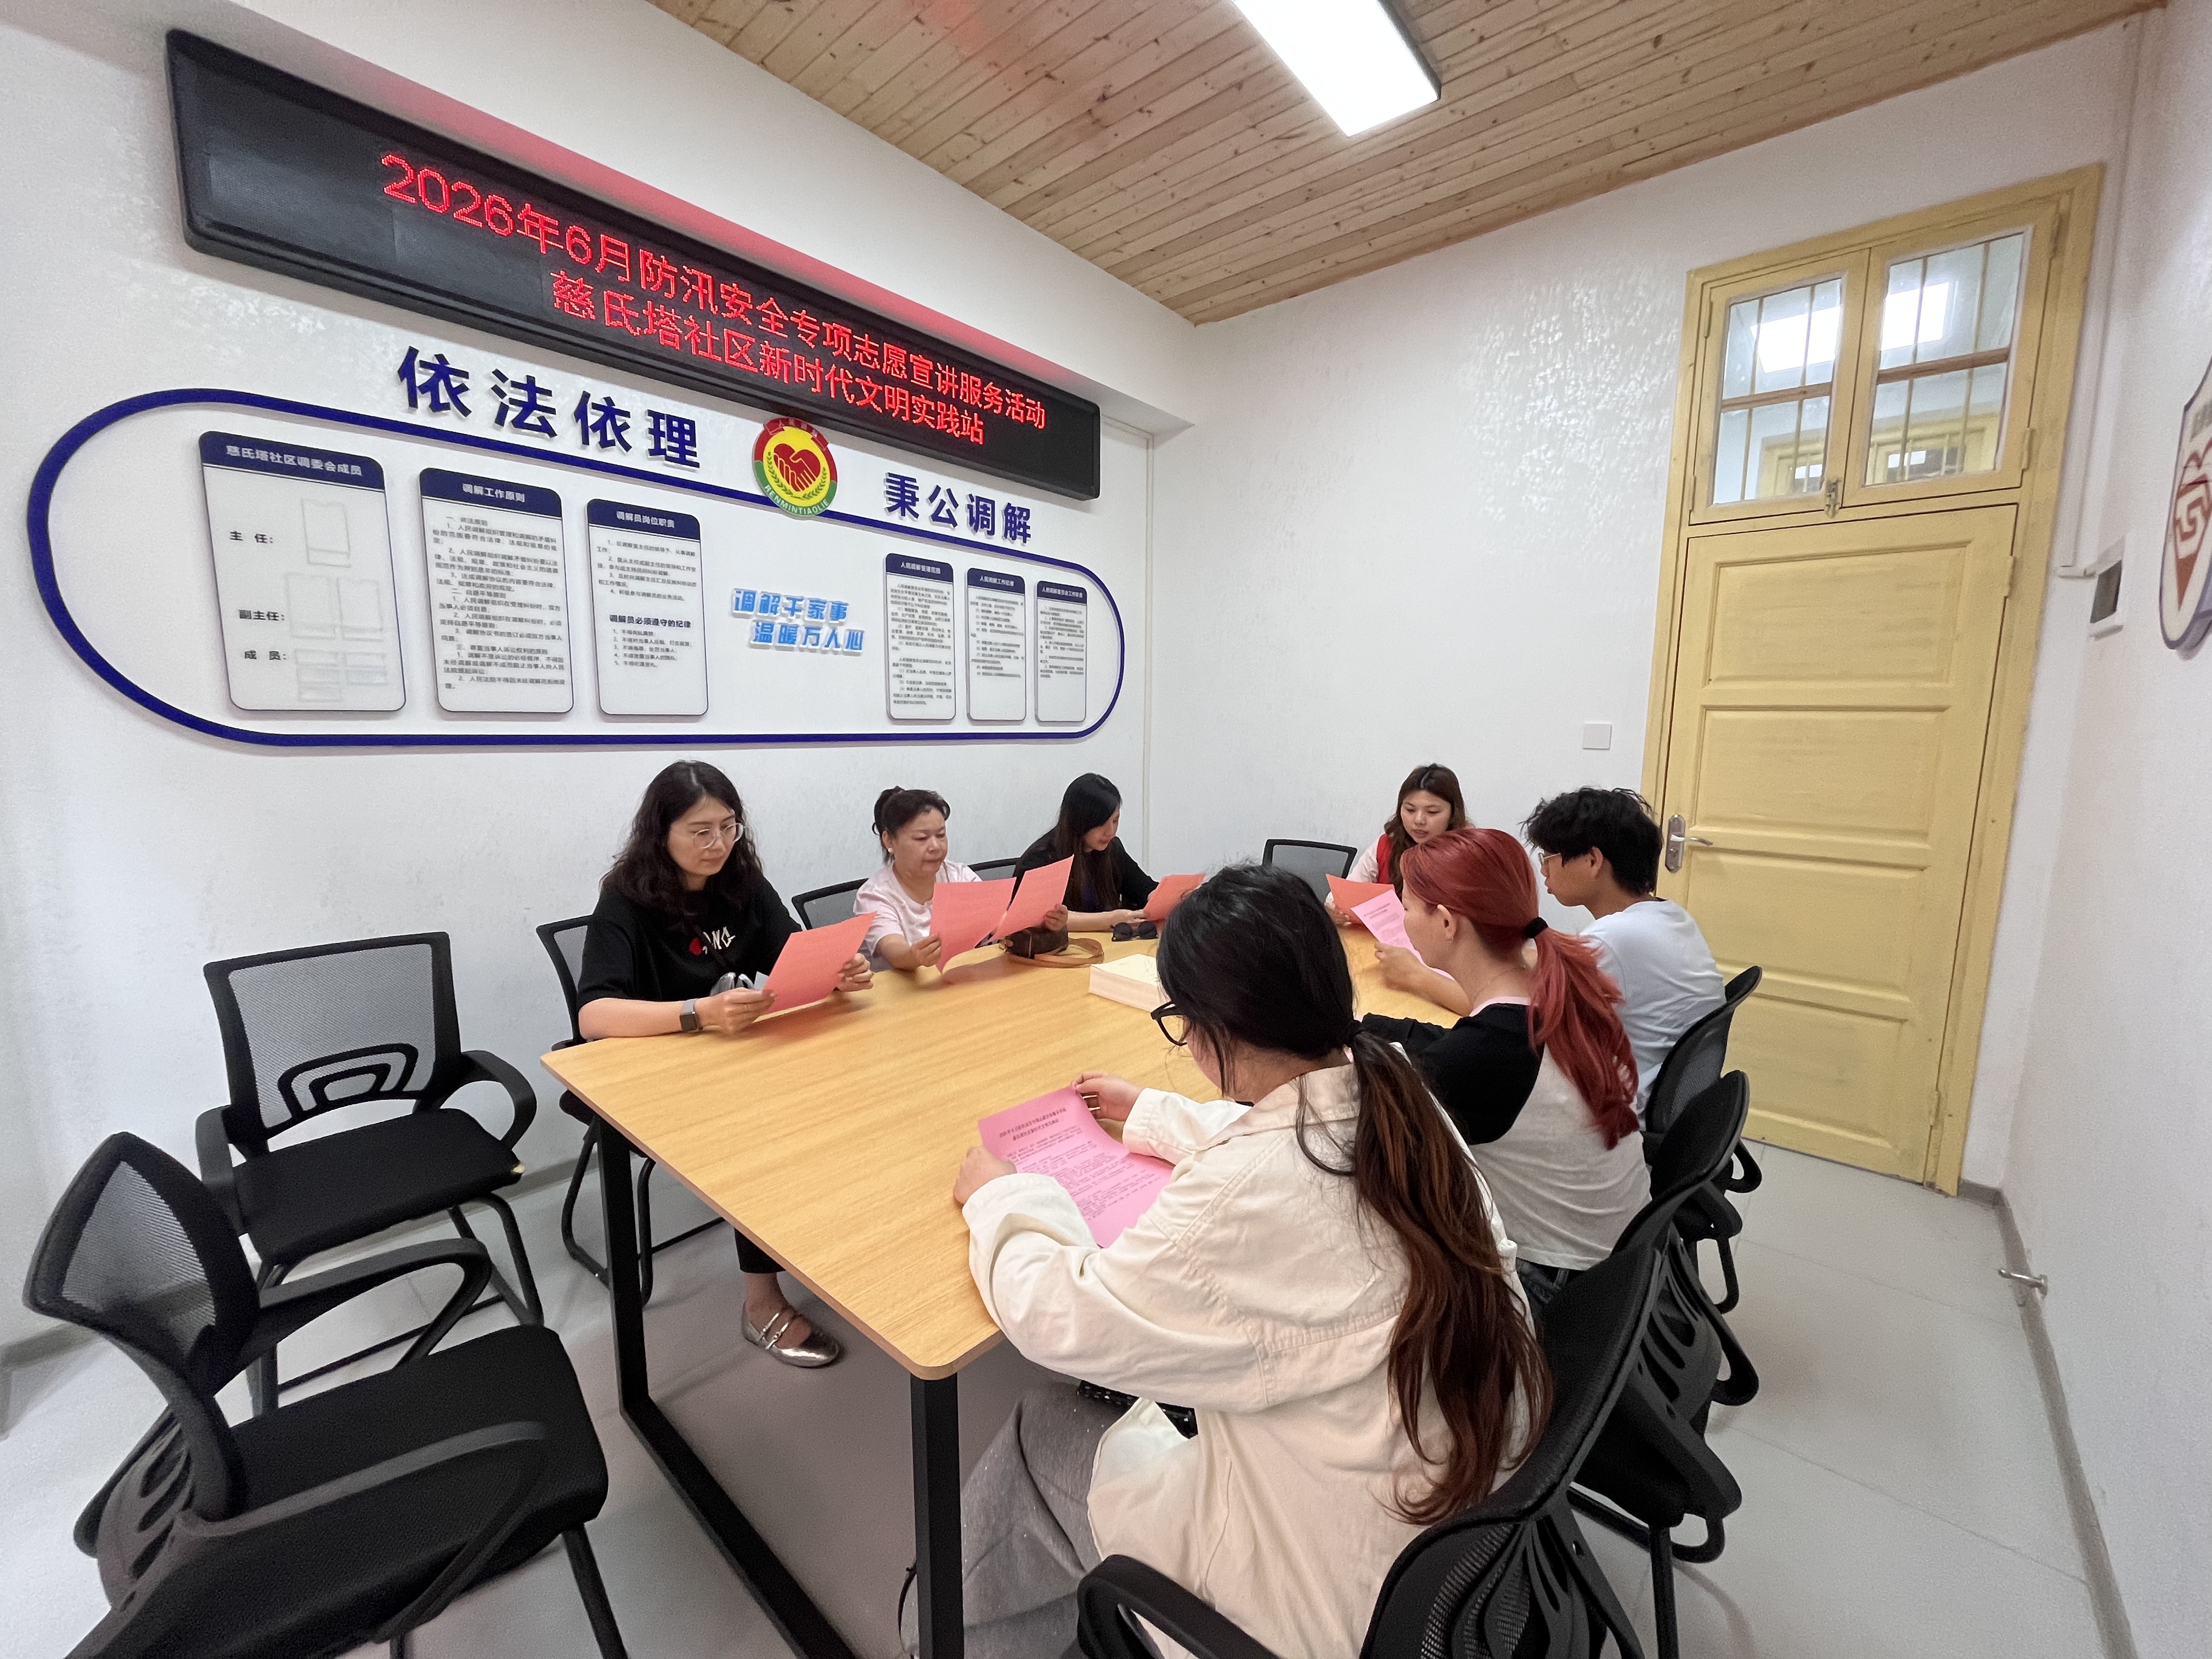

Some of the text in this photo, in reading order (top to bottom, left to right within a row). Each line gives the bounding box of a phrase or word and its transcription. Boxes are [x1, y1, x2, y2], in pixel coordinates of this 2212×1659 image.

[381, 153, 1046, 430] 2026年6月防汛安全专项志愿宣讲服务活动
[550, 269, 984, 445] 慈氏塔社区新时代文明实践站
[397, 346, 700, 468] 依法依理
[225, 444, 363, 477] 慈氏塔社区调委会成员
[462, 483, 526, 503] 调解工作原则
[885, 472, 1031, 544] 秉公调解
[616, 511, 675, 528] 调解员岗位职责
[609, 613, 691, 629] 调解员必须遵守的纪律
[734, 589, 849, 621] 调解千家事
[753, 621, 864, 651] 温暖万人心
